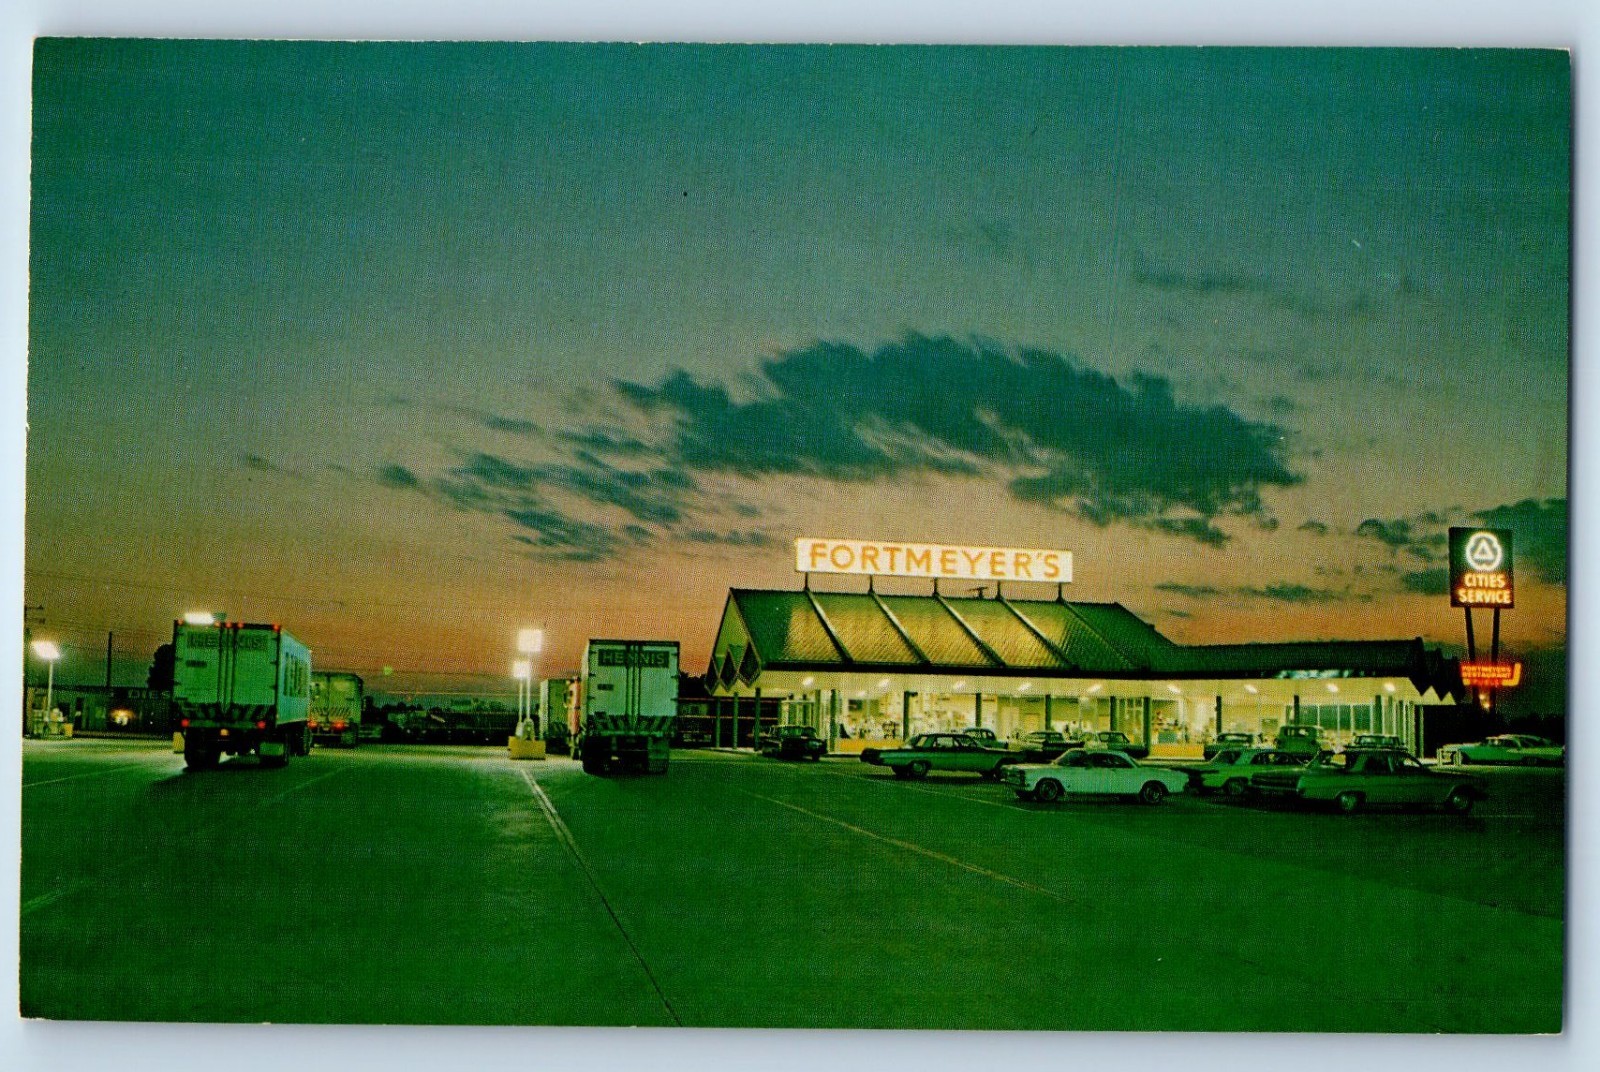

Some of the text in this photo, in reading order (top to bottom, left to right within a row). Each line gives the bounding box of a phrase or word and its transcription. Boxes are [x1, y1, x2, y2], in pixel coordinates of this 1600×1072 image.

[808, 542, 1061, 578] FORTMEYER'S
[1464, 573, 1505, 588] CITIES
[1458, 588, 1511, 603] SERVICE
